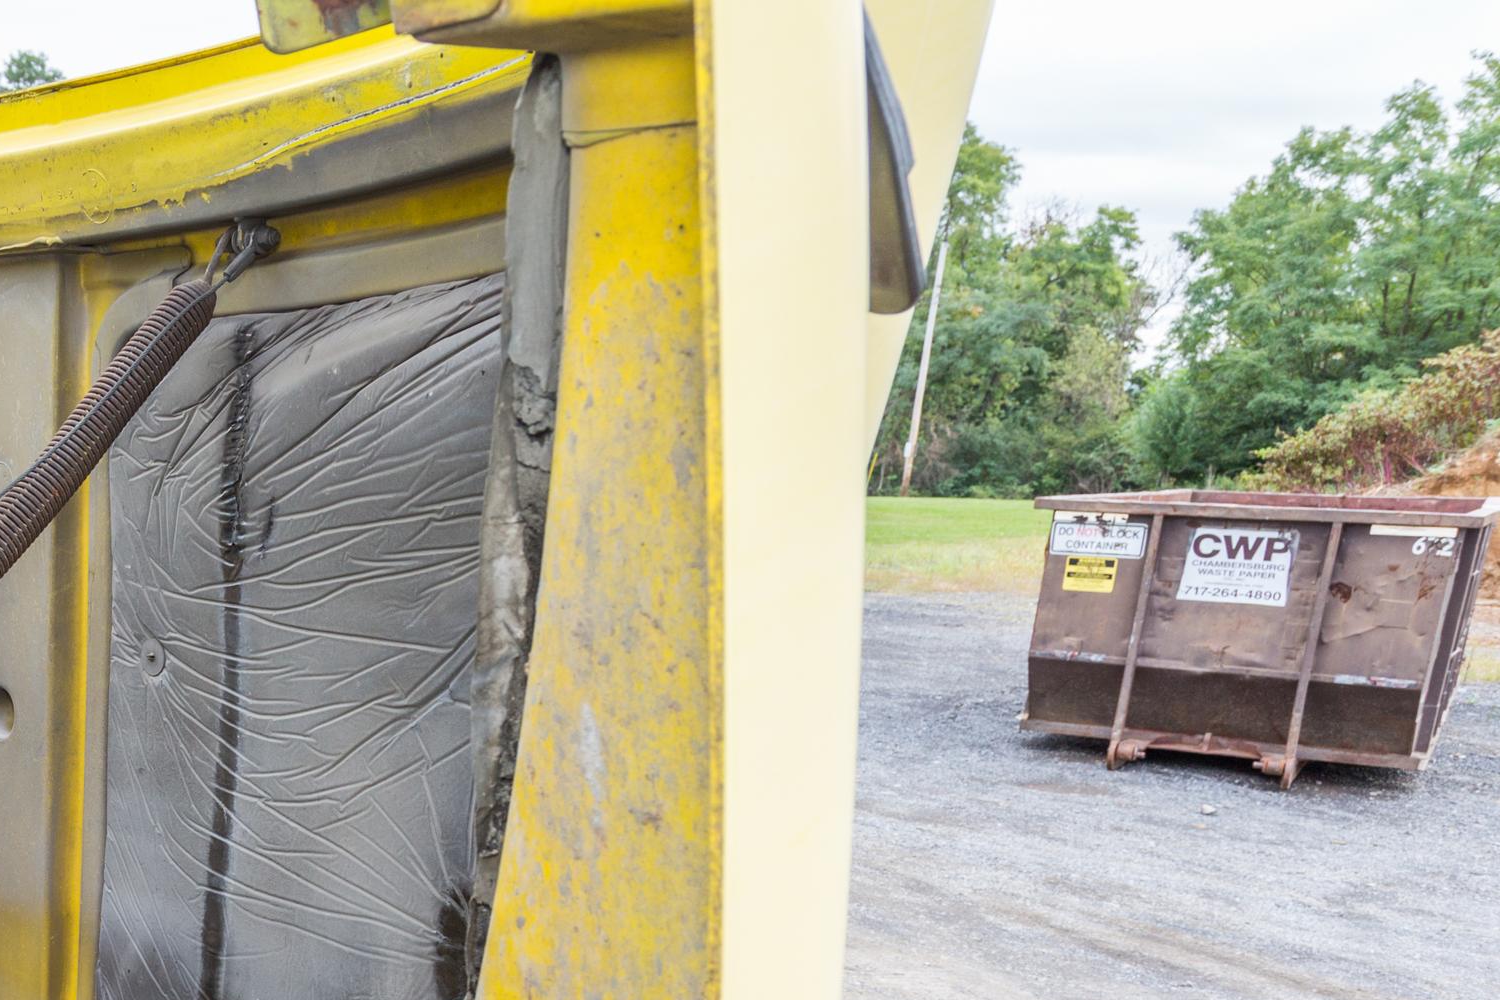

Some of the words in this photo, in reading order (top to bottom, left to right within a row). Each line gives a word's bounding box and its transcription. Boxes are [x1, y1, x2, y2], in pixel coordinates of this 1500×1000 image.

[1058, 527, 1074, 536] DO
[1077, 527, 1100, 538] NOT
[1065, 540, 1129, 551] CONTAINER
[1193, 534, 1291, 561] CWP
[1192, 559, 1285, 572] CHAMBERSBURG
[1198, 568, 1236, 577] WASTE
[1239, 570, 1276, 580] PAPER
[1184, 586, 1282, 602] 717-264-4890
